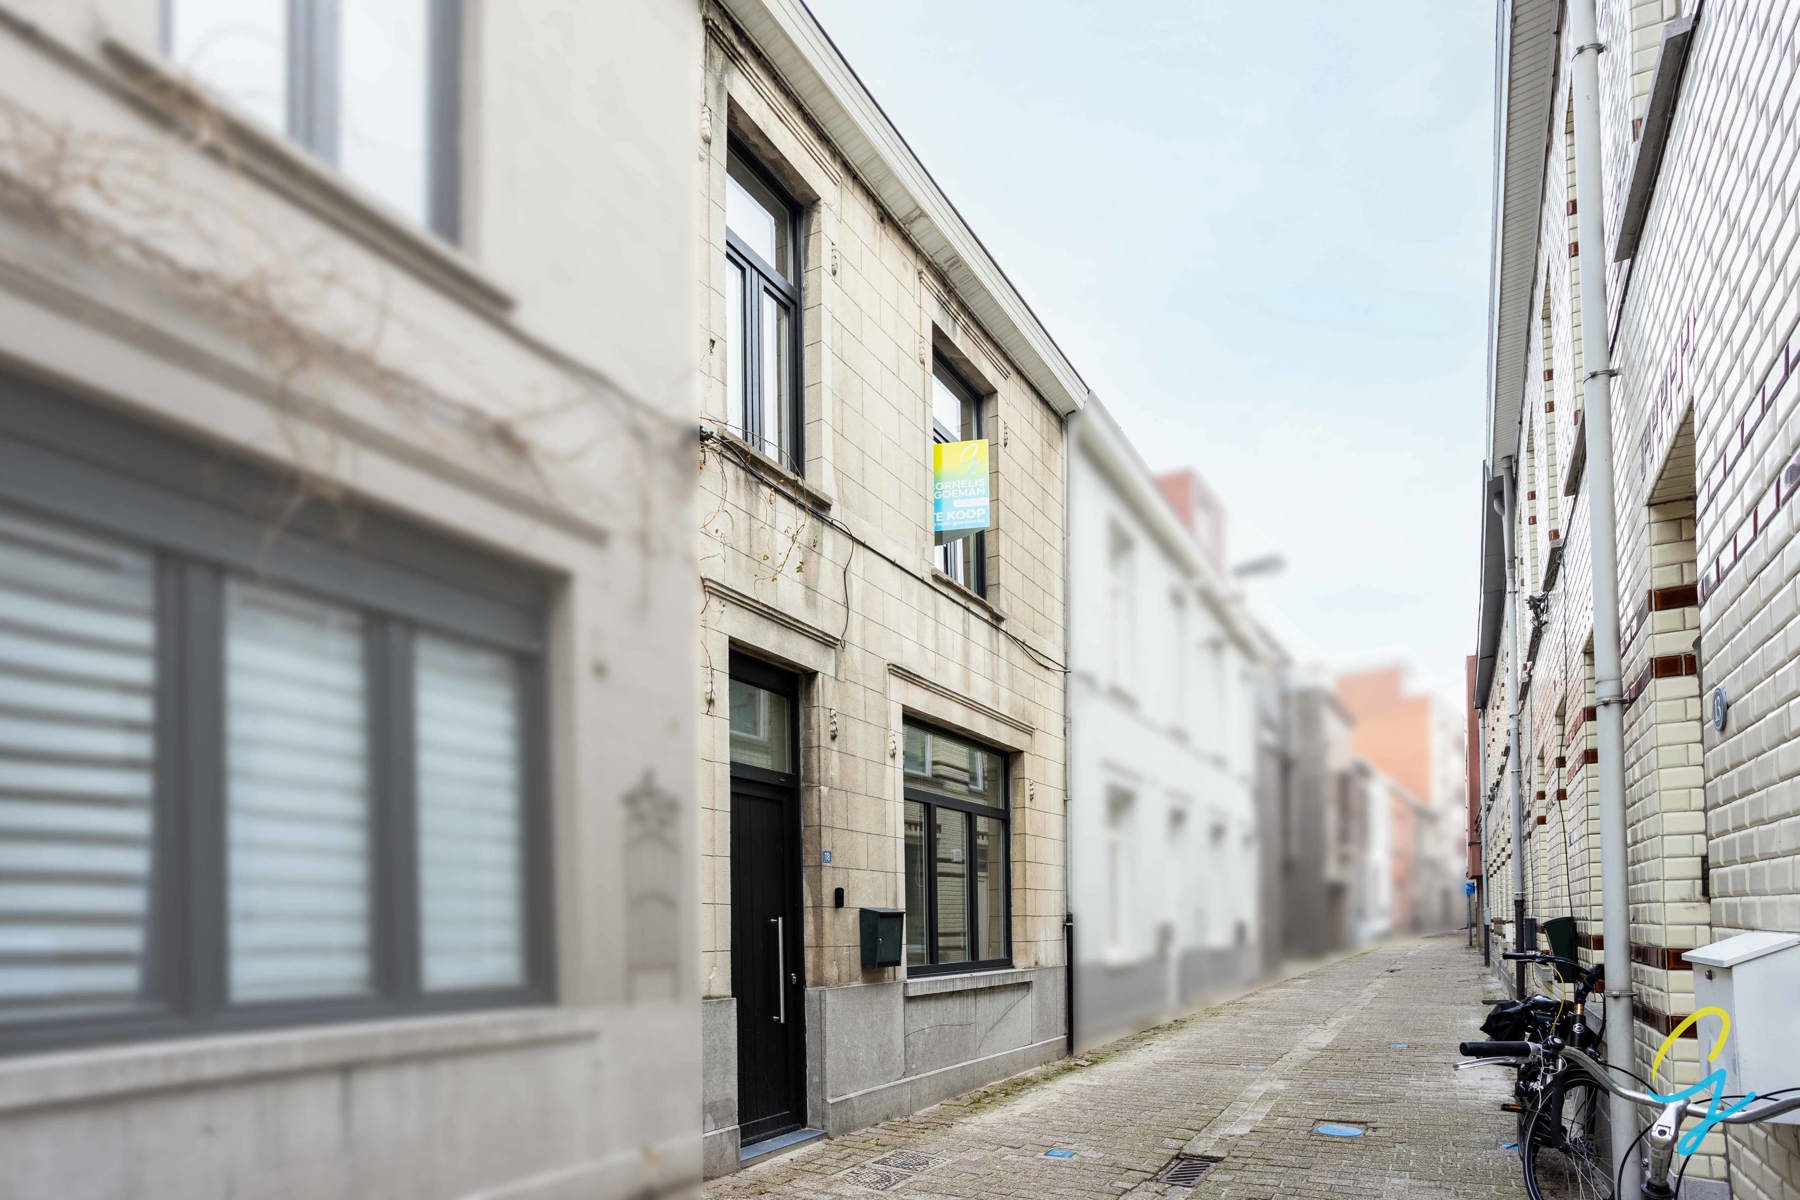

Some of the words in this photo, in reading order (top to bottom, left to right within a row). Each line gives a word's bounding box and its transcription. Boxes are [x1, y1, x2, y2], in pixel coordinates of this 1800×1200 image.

[934, 478, 985, 491] ORNELIS
[934, 487, 986, 499] GOEMAN
[946, 508, 985, 521] KOOP
